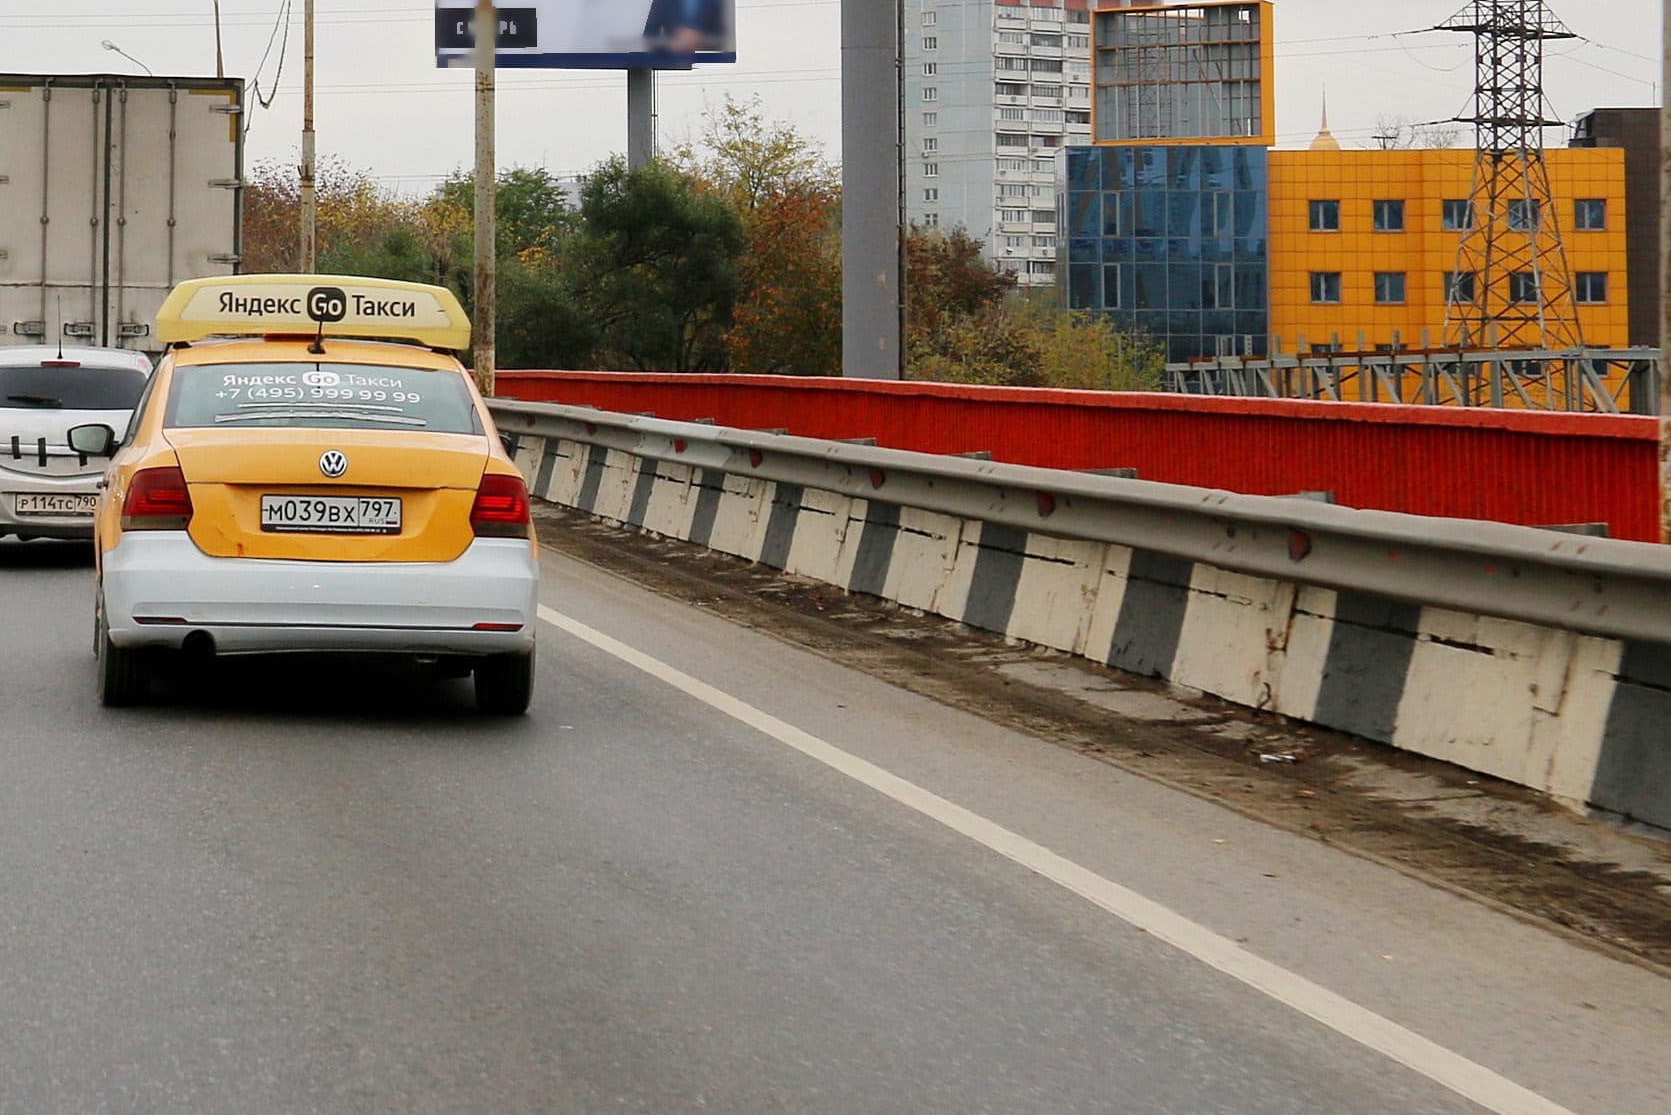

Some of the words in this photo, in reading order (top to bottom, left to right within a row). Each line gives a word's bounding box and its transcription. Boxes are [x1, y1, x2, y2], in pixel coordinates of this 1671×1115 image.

[219, 292, 301, 316] Яндекс
[310, 293, 343, 316] Go
[351, 294, 416, 317] Такси
[223, 373, 297, 387] Яндекс
[306, 372, 339, 386] Go
[345, 374, 403, 388] Такси
[215, 388, 241, 400] +7
[247, 387, 304, 400] (495)
[311, 388, 354, 400] 999
[355, 389, 387, 401] 99
[392, 391, 421, 403] 99
[20, 496, 73, 510] Р114ТС
[75, 495, 97, 507] 790
[268, 500, 356, 523] М039ВХ
[360, 500, 394, 518] 797
